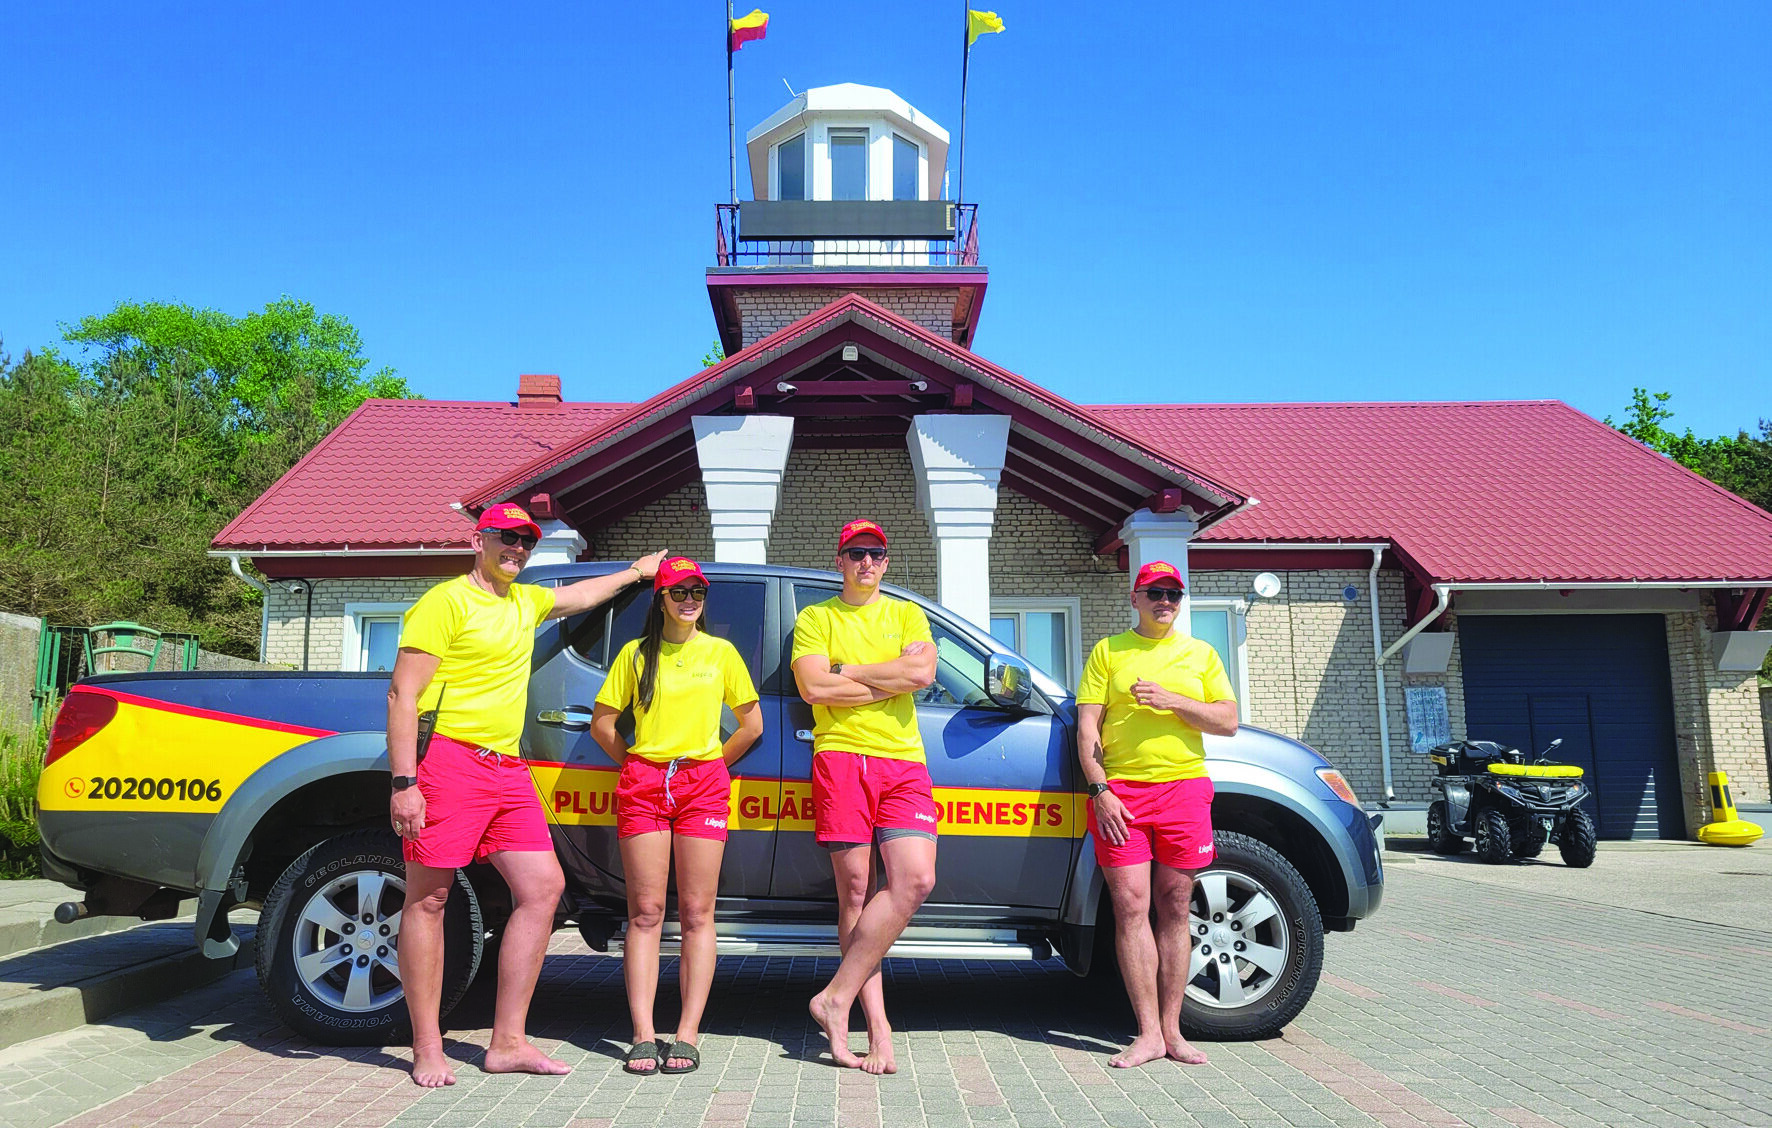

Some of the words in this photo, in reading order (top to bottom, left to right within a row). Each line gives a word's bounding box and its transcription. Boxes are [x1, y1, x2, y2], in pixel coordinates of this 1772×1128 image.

[88, 776, 222, 802] 20200106
[935, 801, 1063, 827] DIENESTS
[1266, 916, 1307, 1012] YOKOHAMA
[291, 994, 393, 1028] YOKOHAMA
